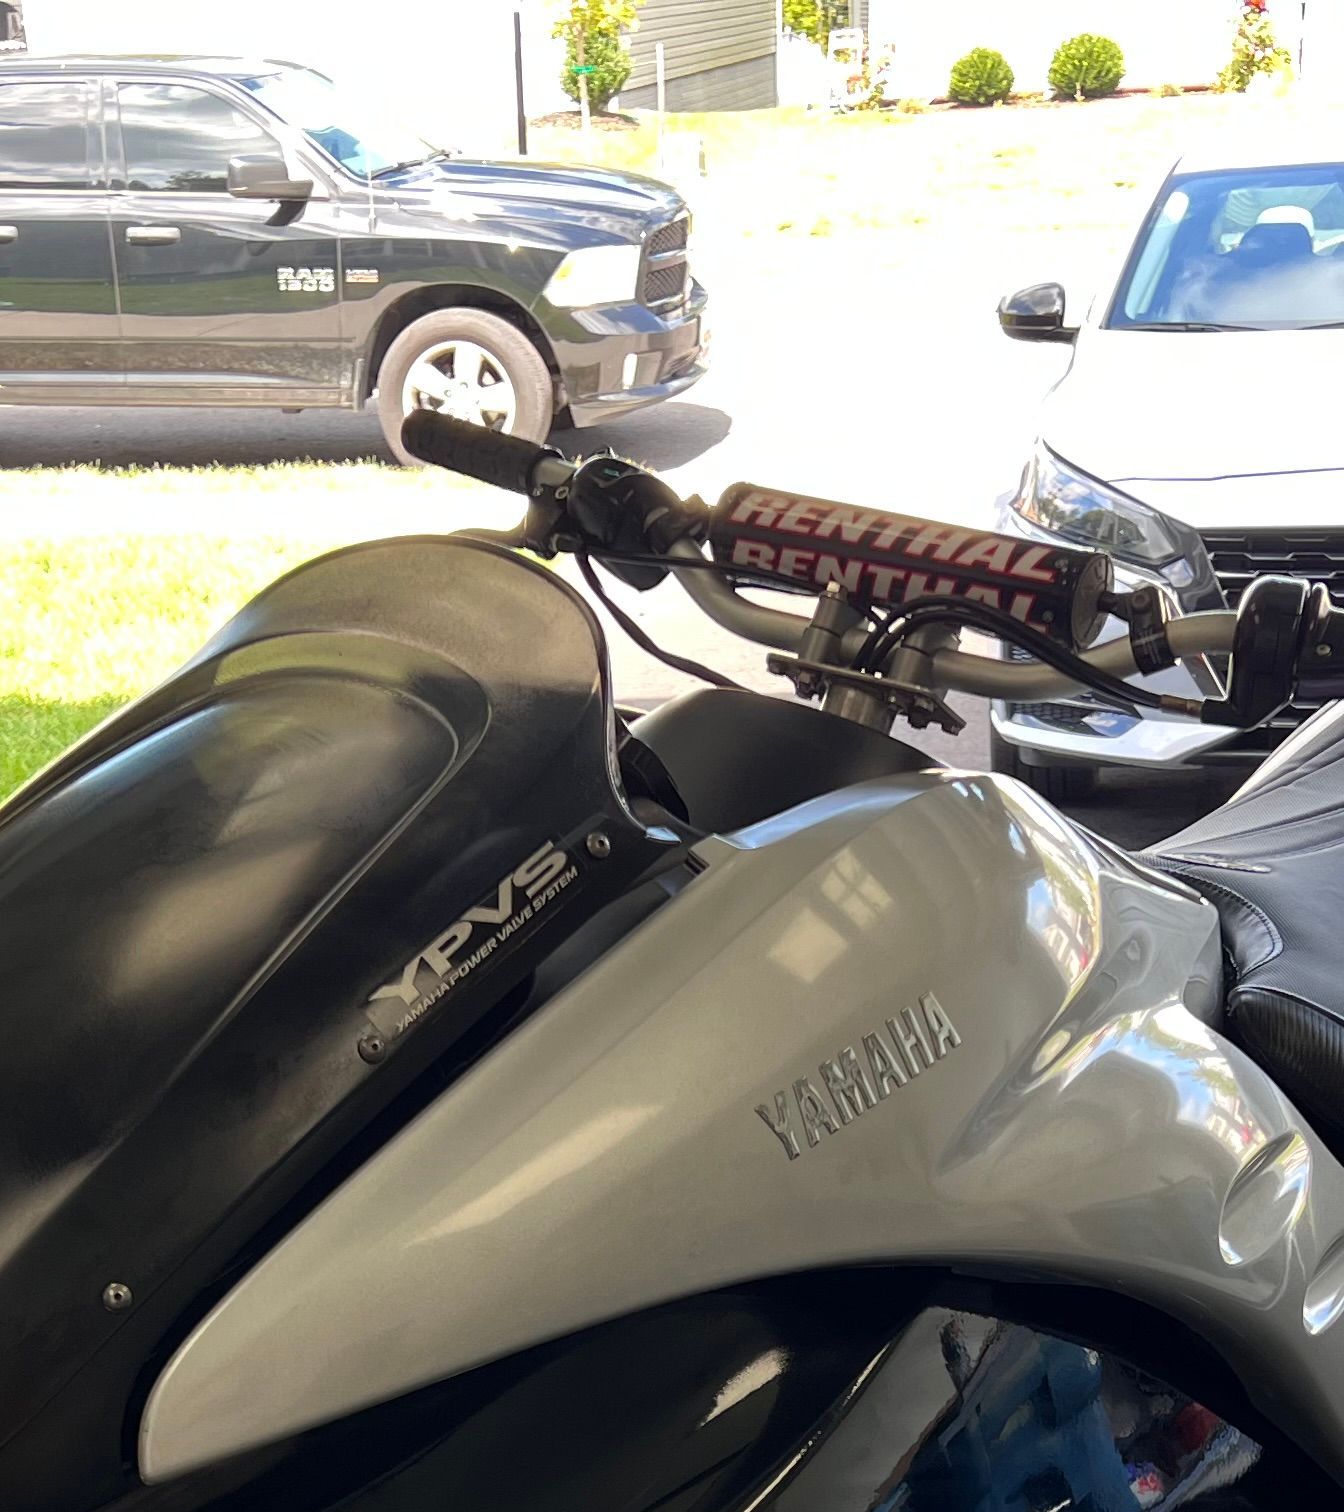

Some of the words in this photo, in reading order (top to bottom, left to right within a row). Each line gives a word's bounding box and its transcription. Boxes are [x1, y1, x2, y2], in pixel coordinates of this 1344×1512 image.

[729, 491, 1056, 584] RENTHAL
[368, 839, 568, 1006] YPVS
[396, 982, 450, 1032] YAMAHA
[449, 937, 498, 986] POWER
[496, 903, 534, 942] VALVE
[532, 865, 579, 912] SYSTEM
[754, 991, 962, 1161] YAMAHA
